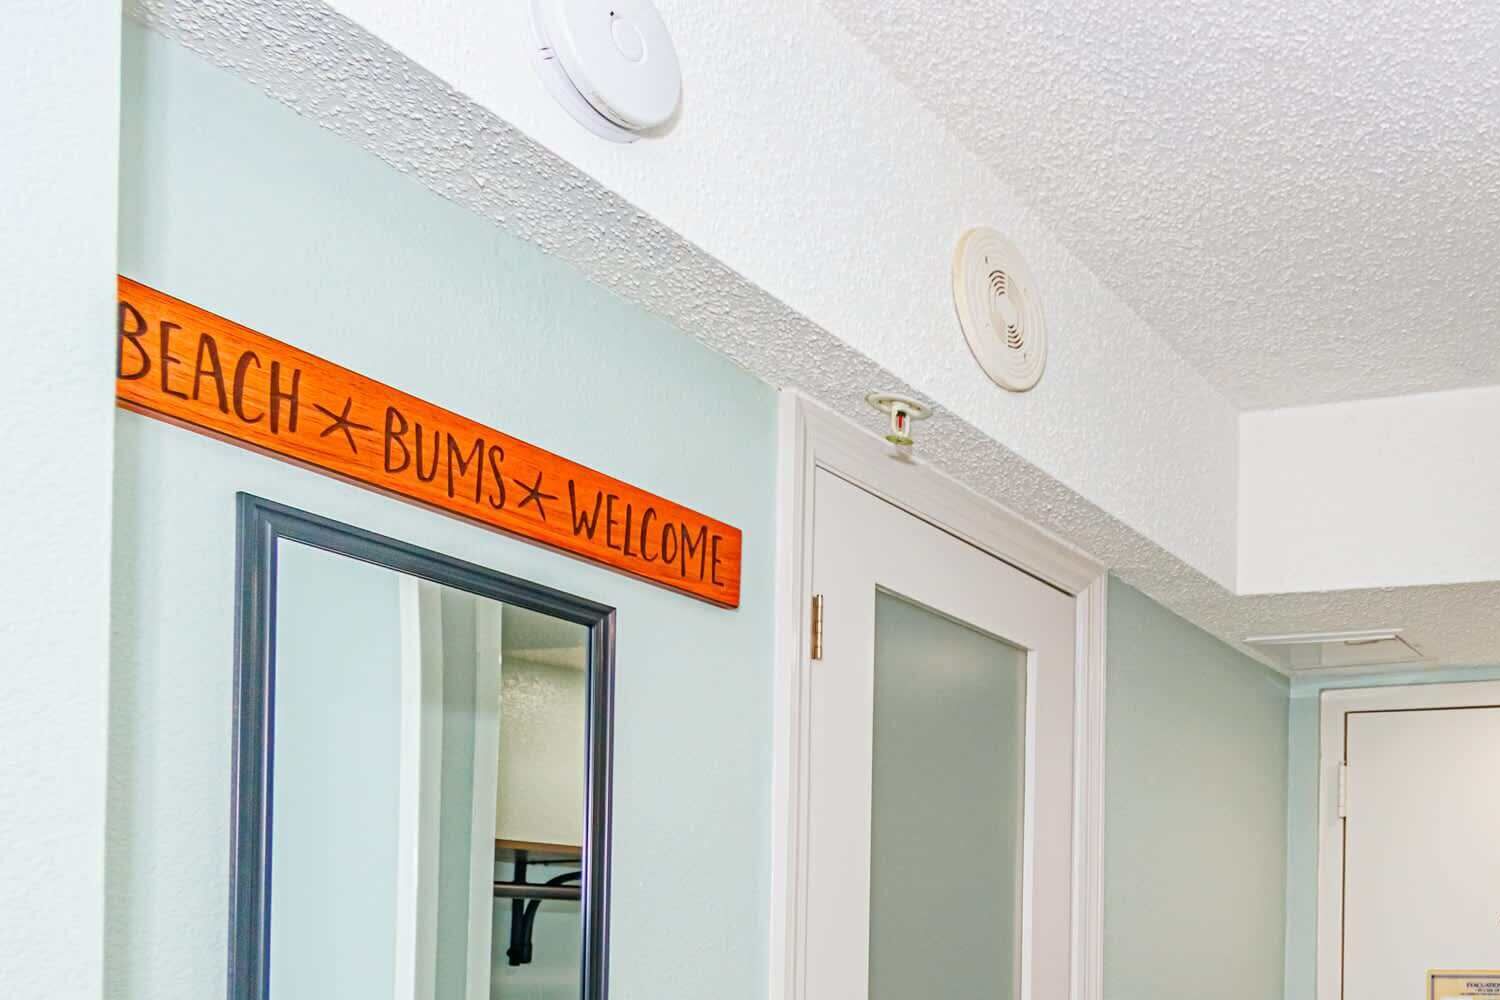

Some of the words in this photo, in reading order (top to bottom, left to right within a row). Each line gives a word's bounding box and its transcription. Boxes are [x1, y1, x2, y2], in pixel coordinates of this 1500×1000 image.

[117, 301, 302, 435] BEACH
[384, 405, 508, 511] BUMS
[566, 479, 727, 588] WELCOME
